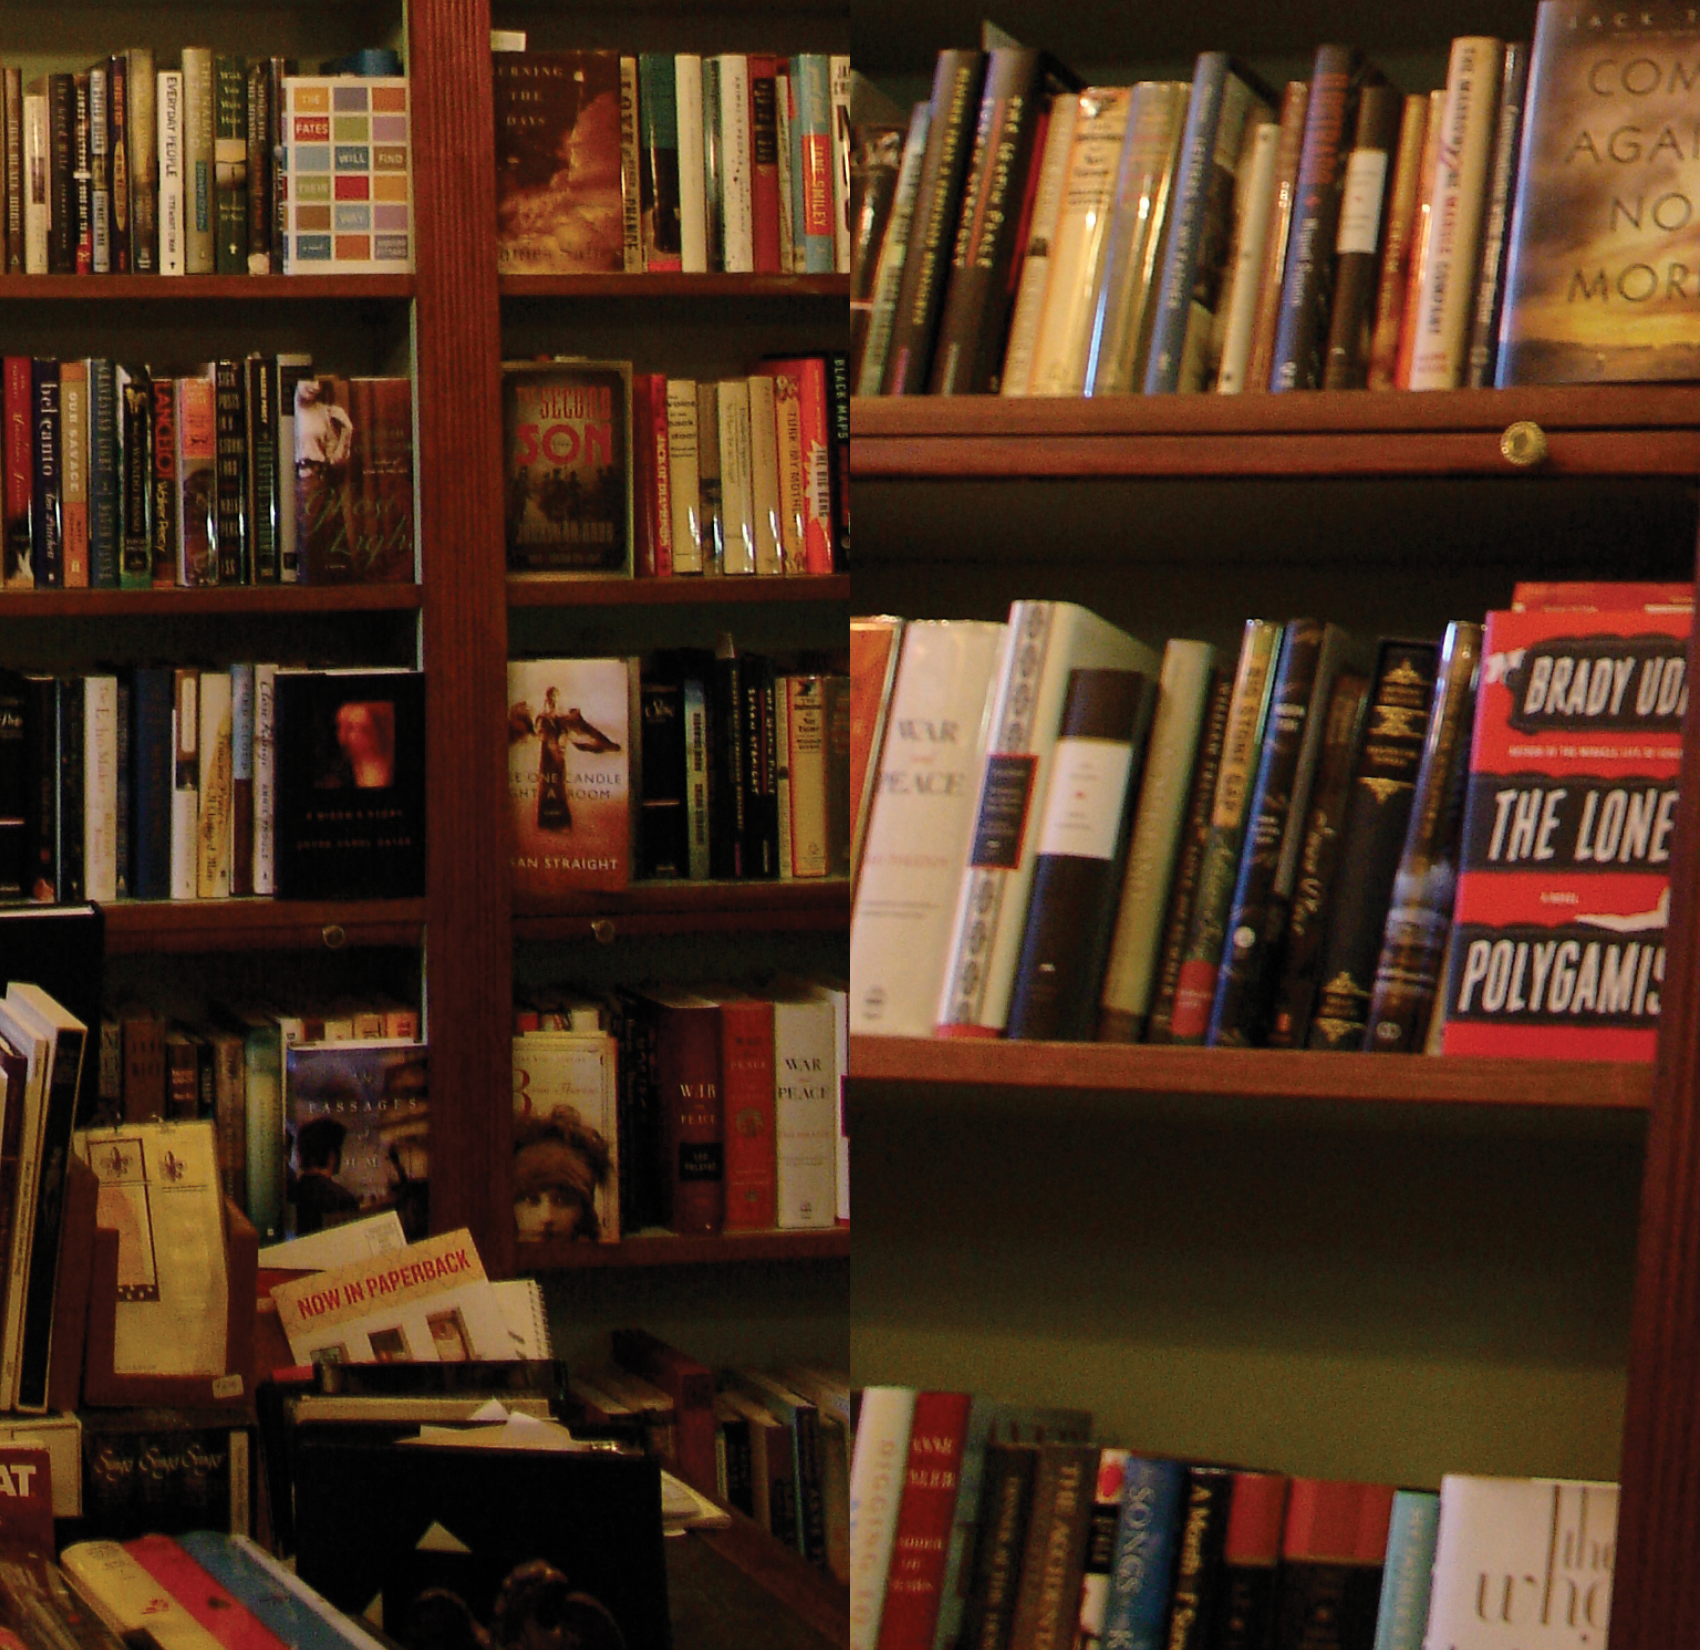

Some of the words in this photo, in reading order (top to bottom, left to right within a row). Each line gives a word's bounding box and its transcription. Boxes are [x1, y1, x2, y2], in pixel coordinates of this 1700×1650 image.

[166, 76, 177, 131] EVERYDAY
[295, 123, 329, 135] FATES
[166, 136, 178, 178] PEOPLE
[339, 153, 366, 165] WILL
[378, 154, 404, 165] FIND
[810, 145, 825, 174] JANE
[811, 176, 827, 227] SMILEY
[1609, 192, 1693, 232] NO
[833, 358, 846, 402] BLACK
[68, 390, 78, 426] OUR
[835, 406, 849, 440] MAPS
[153, 382, 174, 479] LANCELOT
[515, 423, 612, 466] SON
[68, 429, 79, 493] SAVAGE
[1524, 655, 1635, 716] BRADY
[897, 718, 959, 742] WAR
[877, 772, 963, 796] PEACE
[1488, 789, 1567, 863] THE
[1575, 788, 1681, 863] LONE
[544, 858, 618, 870] STRAIGHT
[785, 1057, 823, 1074] WAR
[777, 1084, 832, 1102] PEACE
[298, 1292, 341, 1320] NOW
[343, 1286, 365, 1309] IN
[366, 1249, 471, 1301] PAPERBACK
[1117, 1483, 1154, 1590] SONGS
